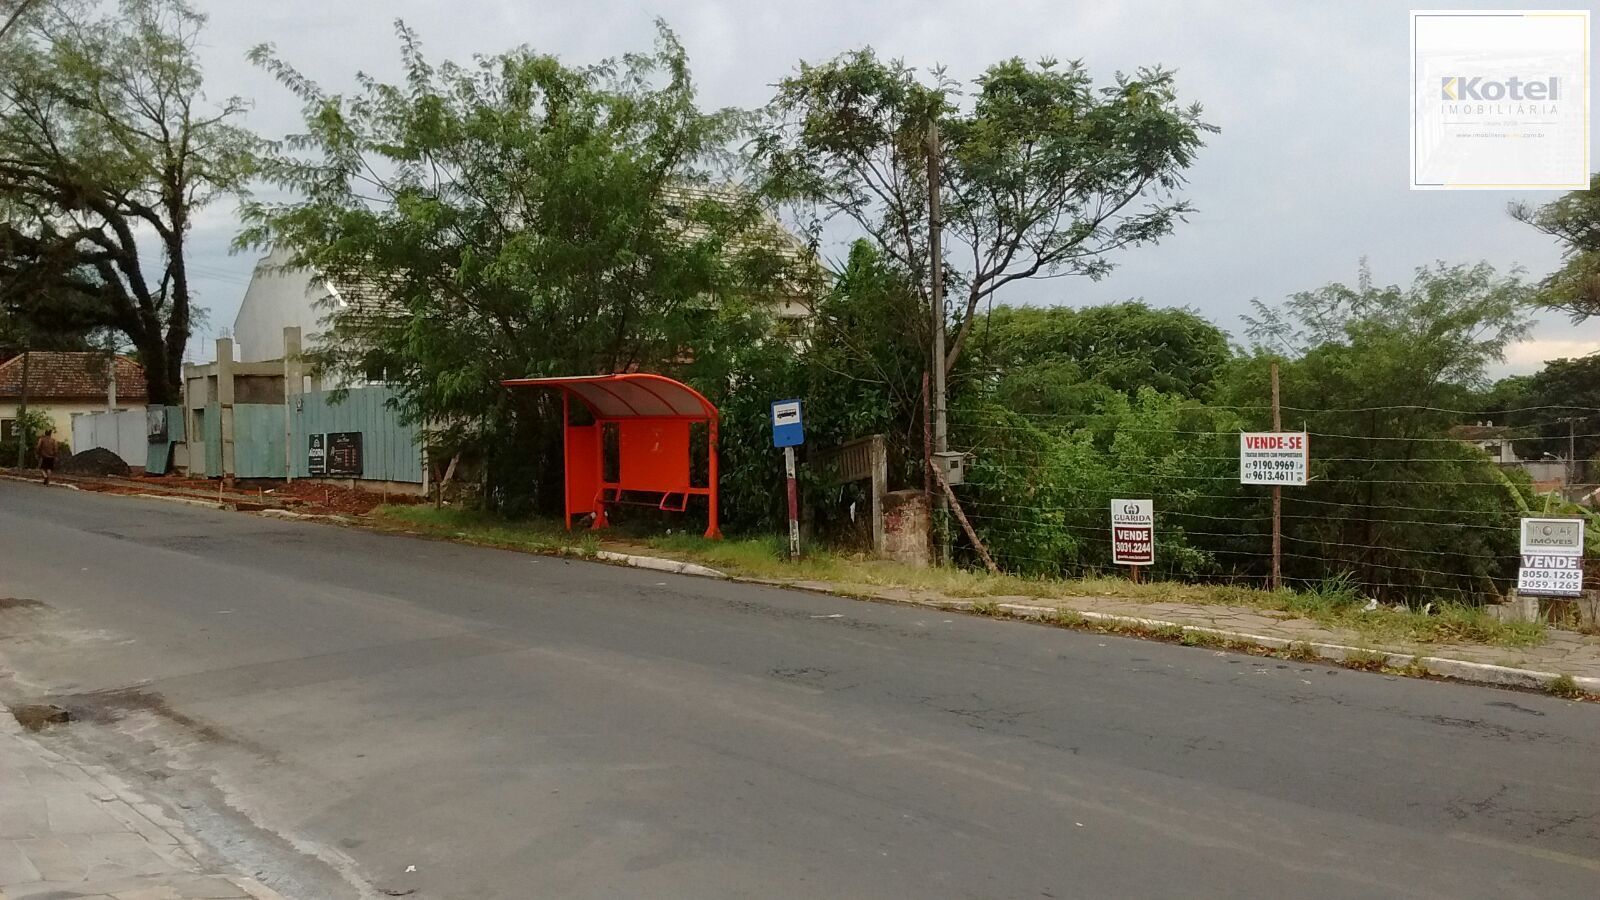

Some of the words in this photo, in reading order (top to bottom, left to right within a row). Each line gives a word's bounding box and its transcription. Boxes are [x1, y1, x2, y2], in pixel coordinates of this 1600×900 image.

[1246, 437, 1302, 449] VENDE-SE
[1252, 460, 1294, 470] 9190.9969
[1252, 471, 1294, 480] 9613.4611
[1117, 530, 1149, 540] VENDE
[1116, 542, 1151, 552] 3031.2244
[1522, 555, 1577, 569] VENDE
[1522, 570, 1580, 580] 8050.1265
[1521, 580, 1579, 590] 3059.1265
